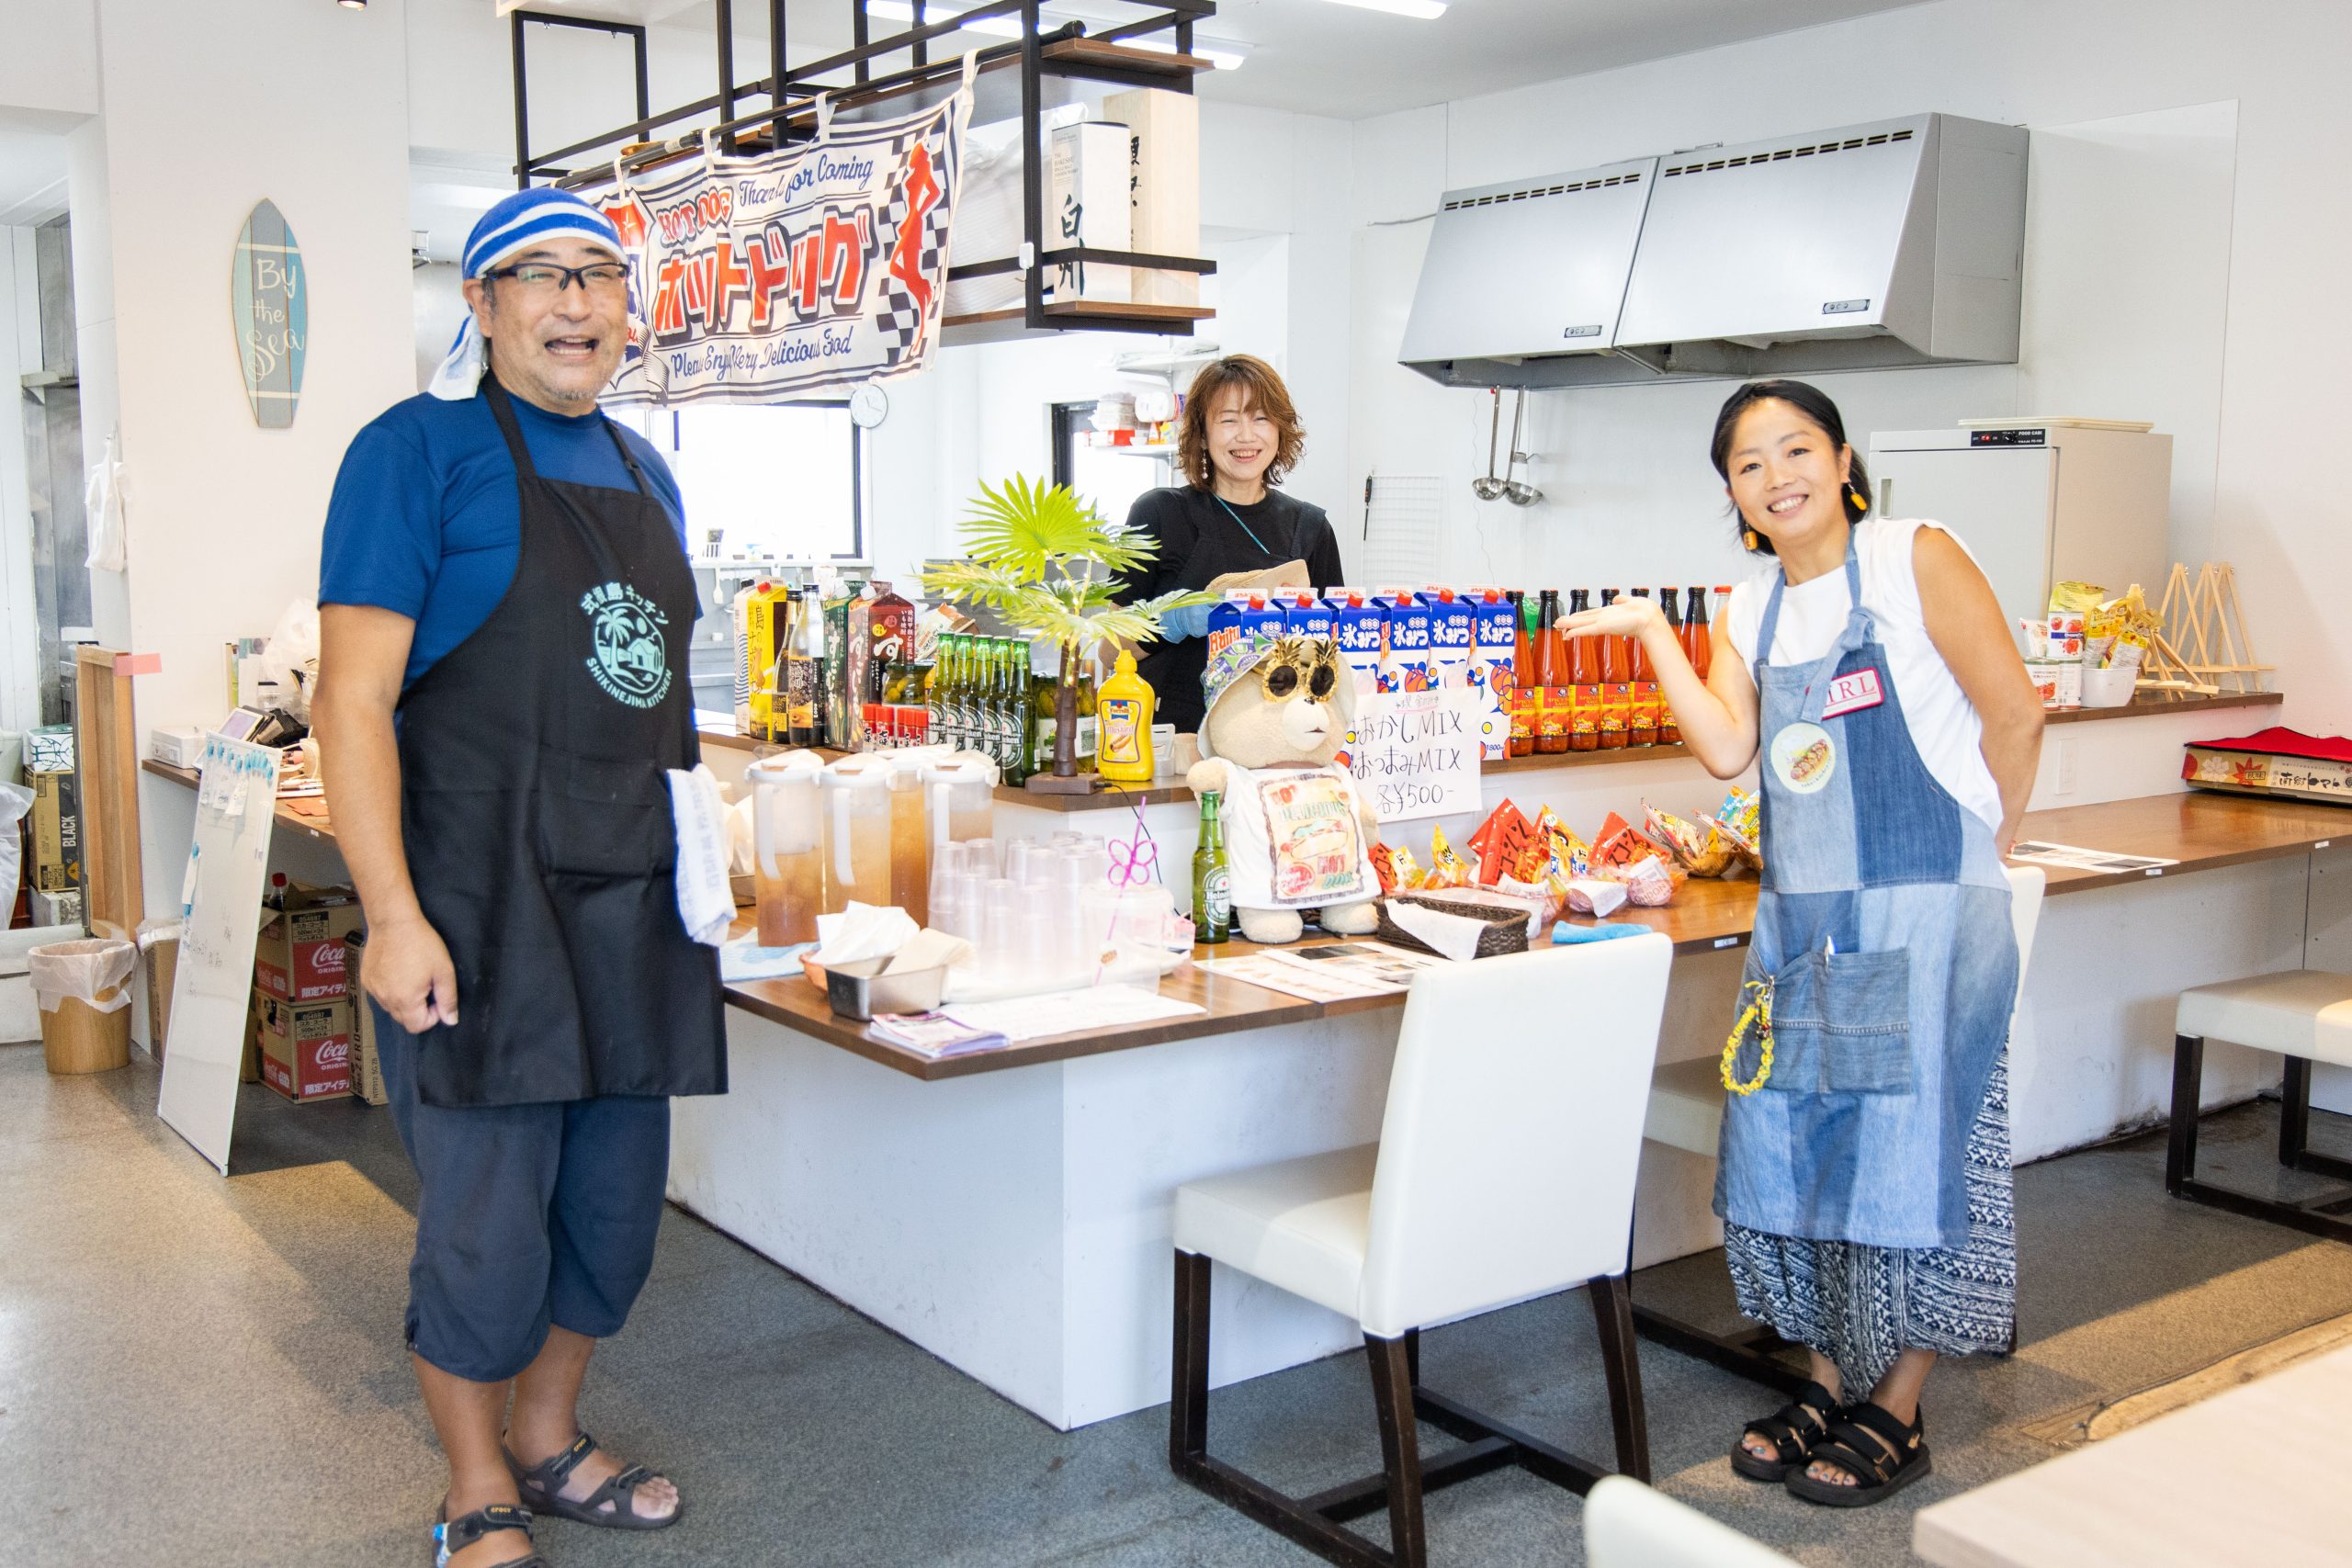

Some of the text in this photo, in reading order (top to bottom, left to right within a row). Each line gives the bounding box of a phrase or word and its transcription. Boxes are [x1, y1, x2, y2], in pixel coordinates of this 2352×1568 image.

[785, 169, 815, 203] for
[817, 152, 874, 191] Coming
[659, 188, 733, 243] HOT DOG
[256, 259, 297, 299] By
[248, 299, 286, 326] the
[244, 327, 305, 383] Sea
[1342, 623, 1380, 649] 氷みつ
[1394, 621, 1429, 648] 氷みつ
[1432, 618, 1469, 645] 氷みつ
[1479, 618, 1514, 644] 氷みつ
[586, 657, 673, 709] SHIKINEJIMA KITCHEN
[1827, 676, 1875, 704] IRL
[1106, 725, 1135, 736] Mustard
[61, 815, 76, 848] BLACK
[311, 943, 345, 968] Coca
[315, 1040, 348, 1065] Coca
[321, 1062, 348, 1071] ORIGIN
